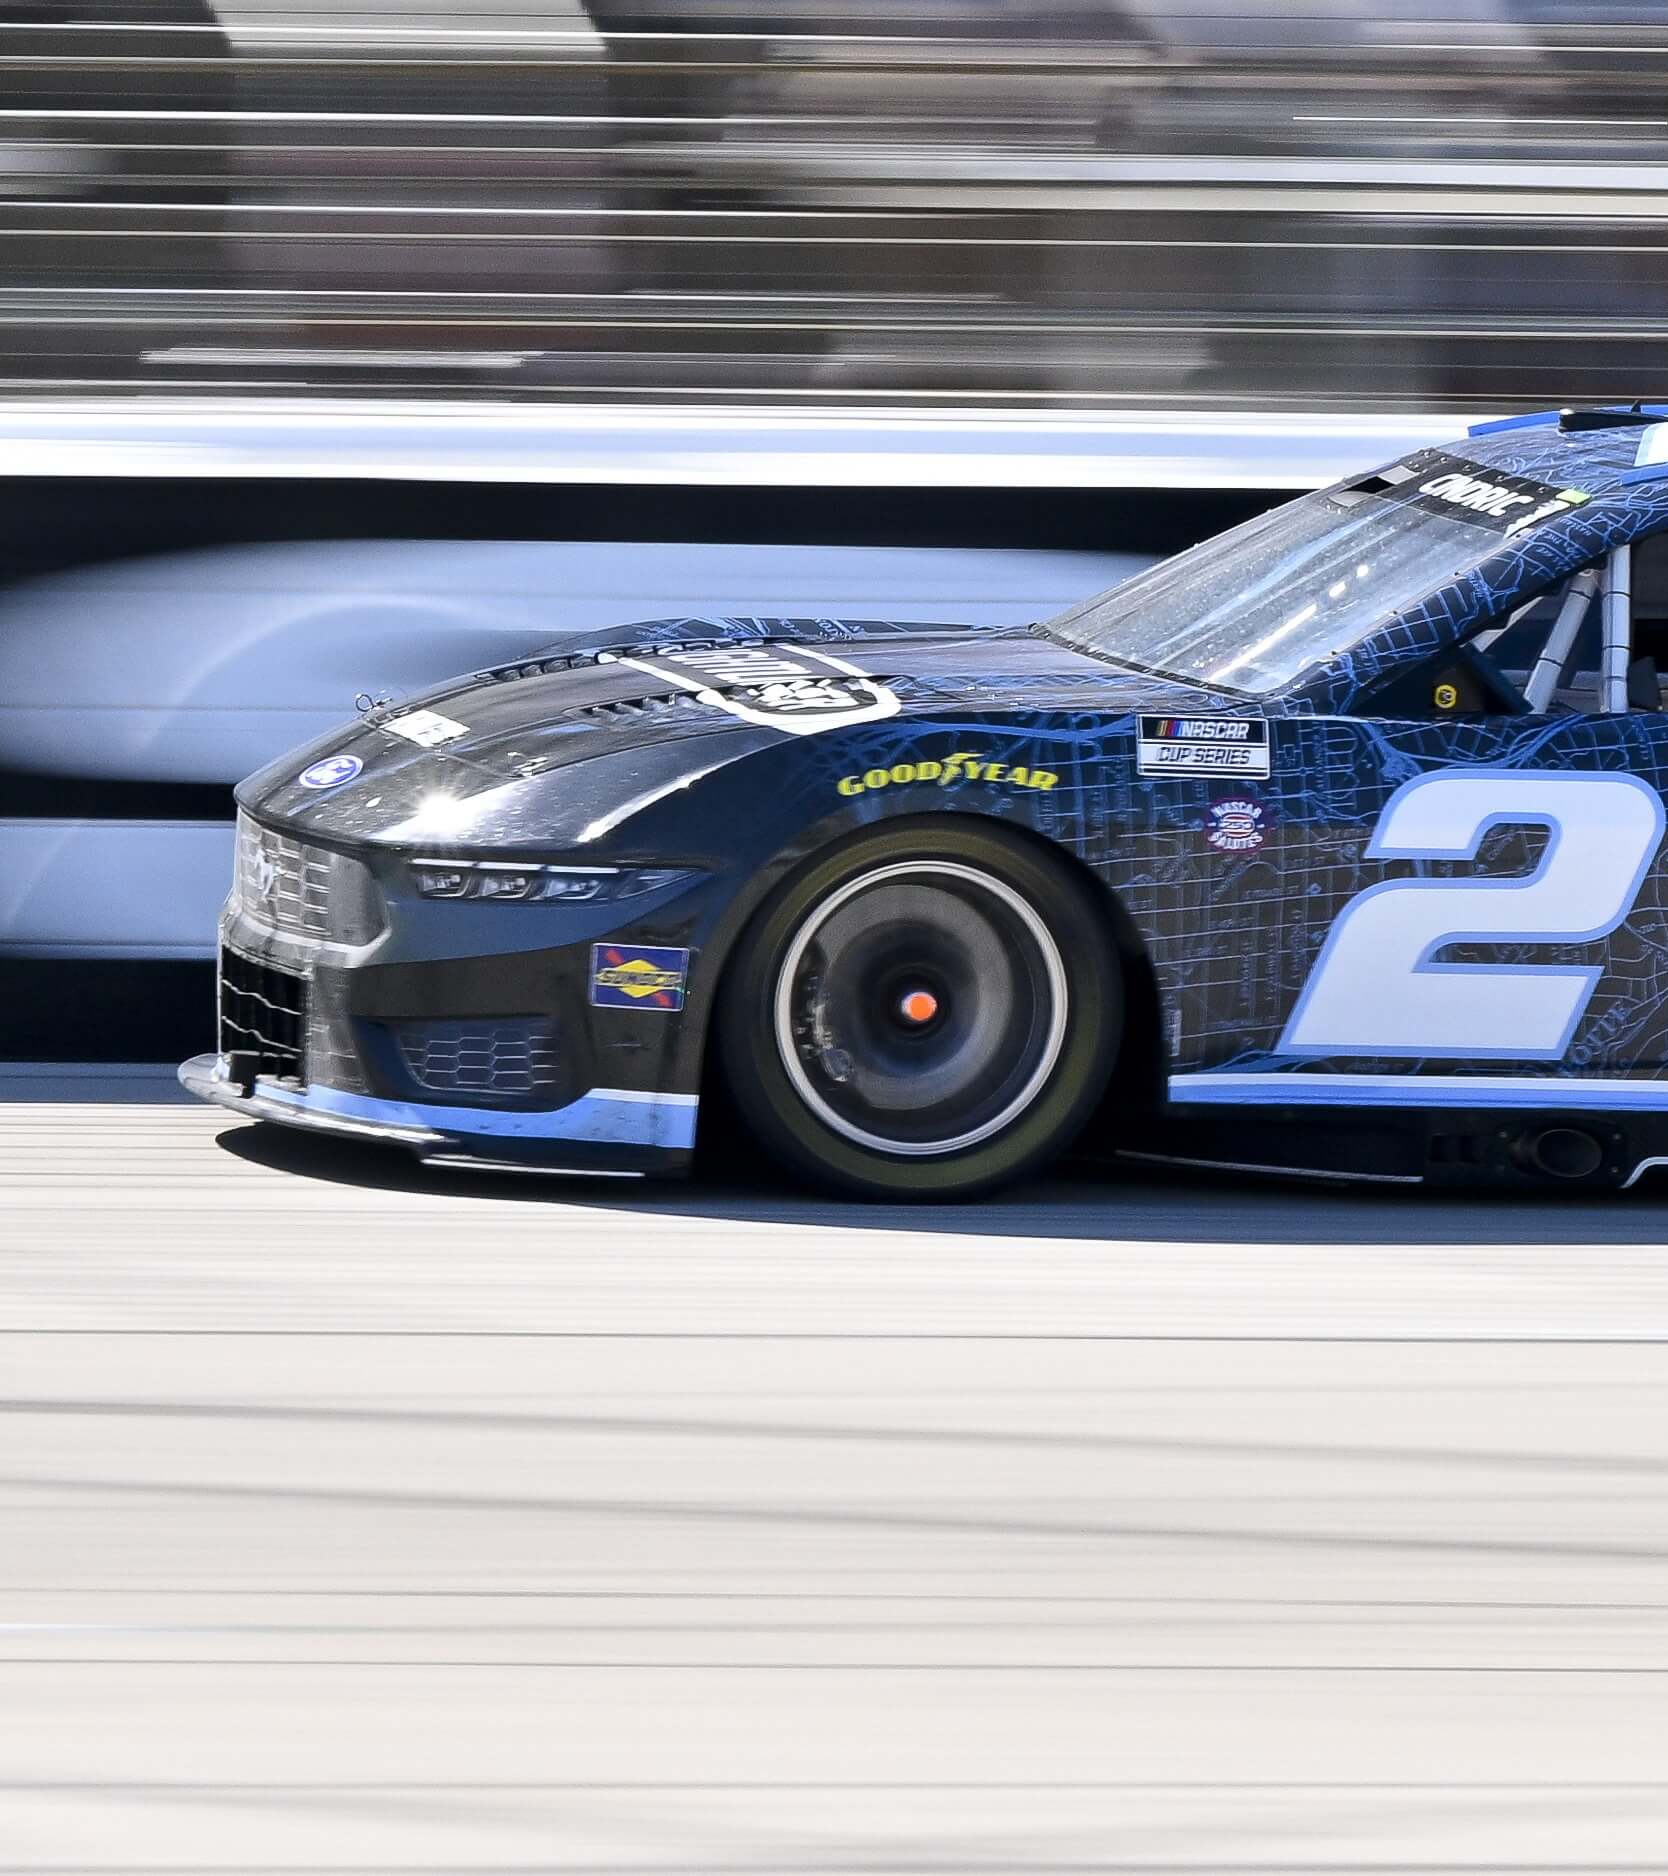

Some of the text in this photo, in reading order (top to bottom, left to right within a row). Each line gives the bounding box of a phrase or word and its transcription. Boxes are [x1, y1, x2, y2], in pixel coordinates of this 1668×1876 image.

[1181, 720, 1250, 740] NASCAR
[1157, 746, 1250, 765] CUP SERIES
[837, 752, 1060, 797] GOODYEAR
[1210, 802, 1262, 819] NASCAR
[1208, 831, 1264, 850] SALUTES
[1275, 768, 1667, 1060] 2
